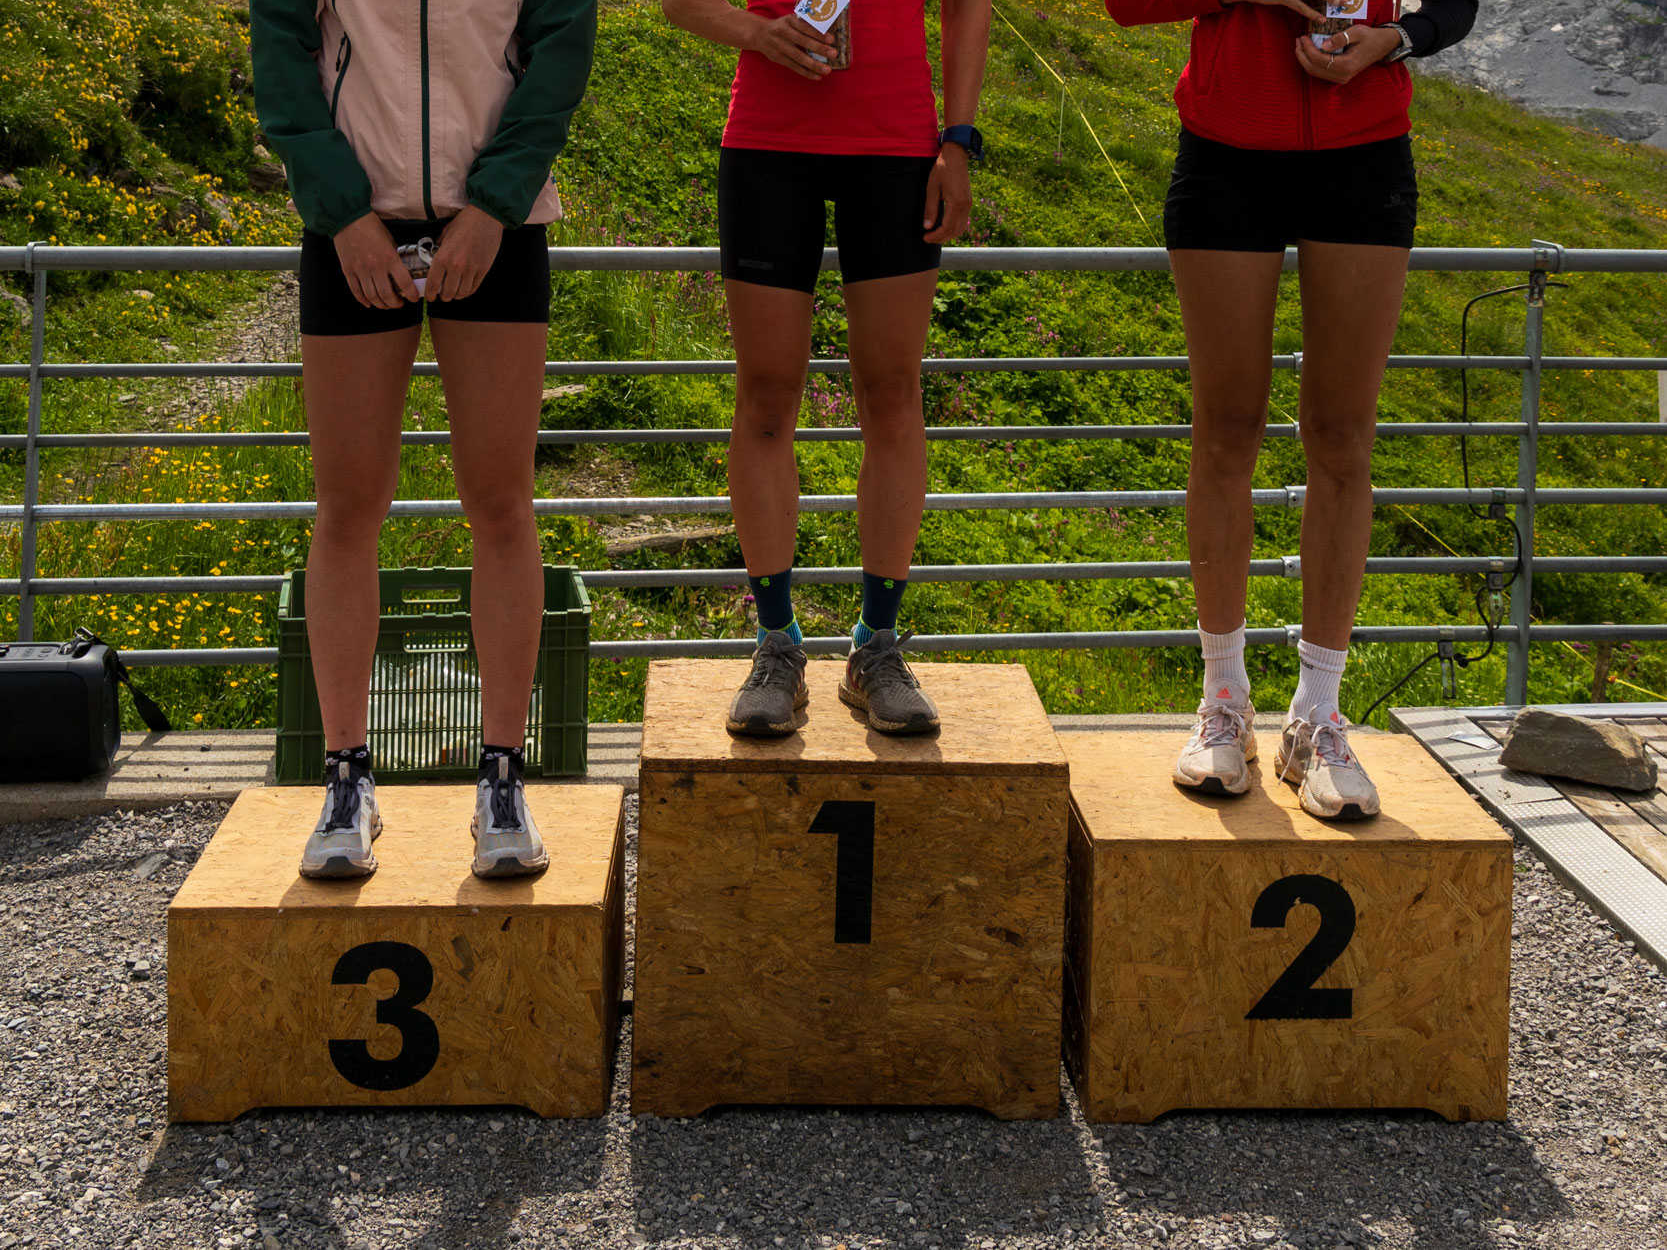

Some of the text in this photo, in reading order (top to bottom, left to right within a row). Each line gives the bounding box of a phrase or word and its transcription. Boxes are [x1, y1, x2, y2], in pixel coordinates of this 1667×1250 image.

[809, 800, 876, 945] 1
[328, 941, 440, 1091] 3
[1248, 874, 1356, 1020] 2
